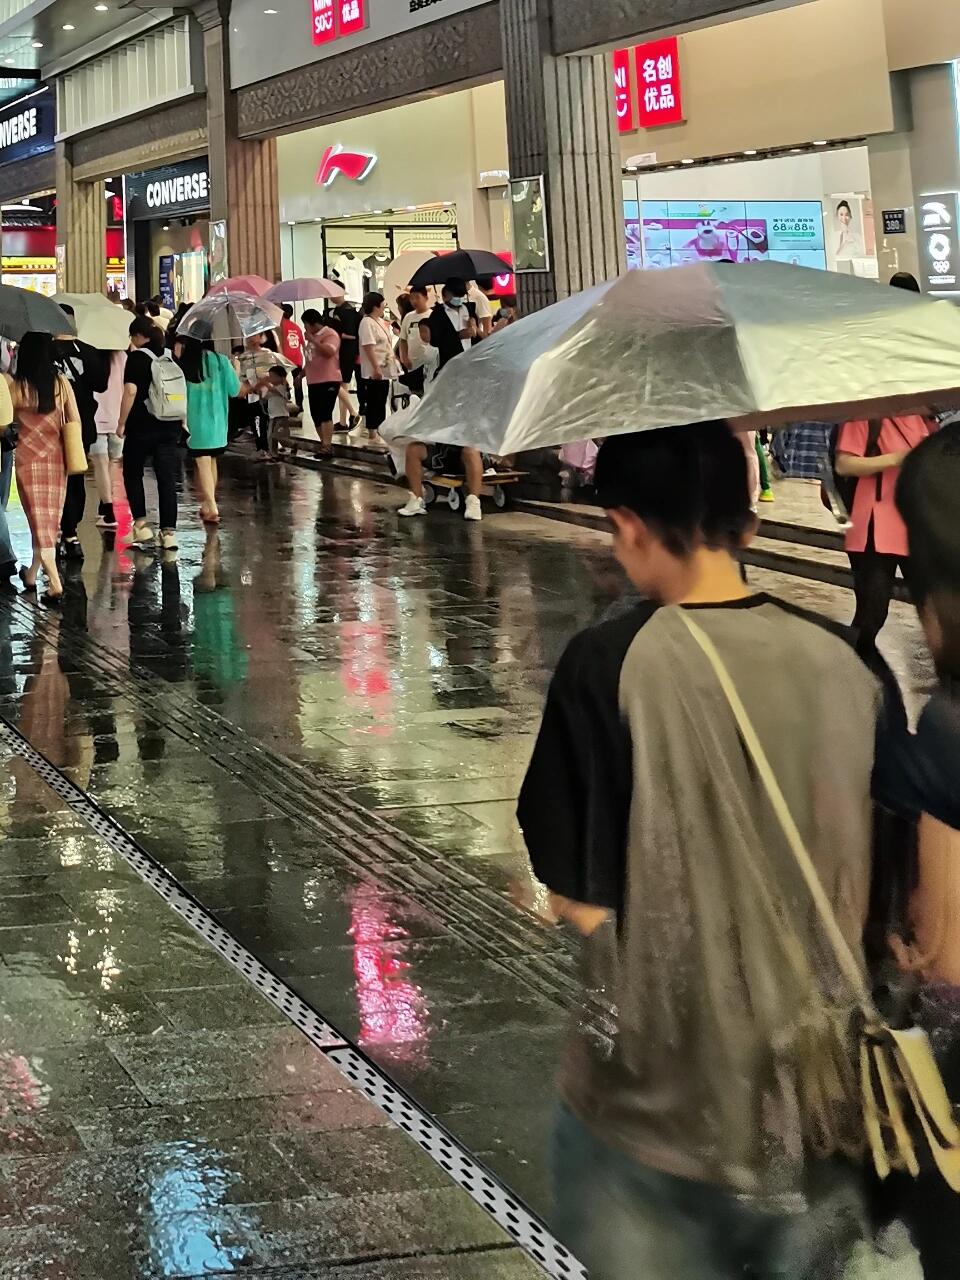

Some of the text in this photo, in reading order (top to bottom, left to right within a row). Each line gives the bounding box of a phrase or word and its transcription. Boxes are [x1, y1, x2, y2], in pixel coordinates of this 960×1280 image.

[341, 0, 360, 24] 优品
[642, 54, 673, 83] 名创
[644, 84, 675, 112] 优品
[146, 171, 208, 208] CONVERSE
